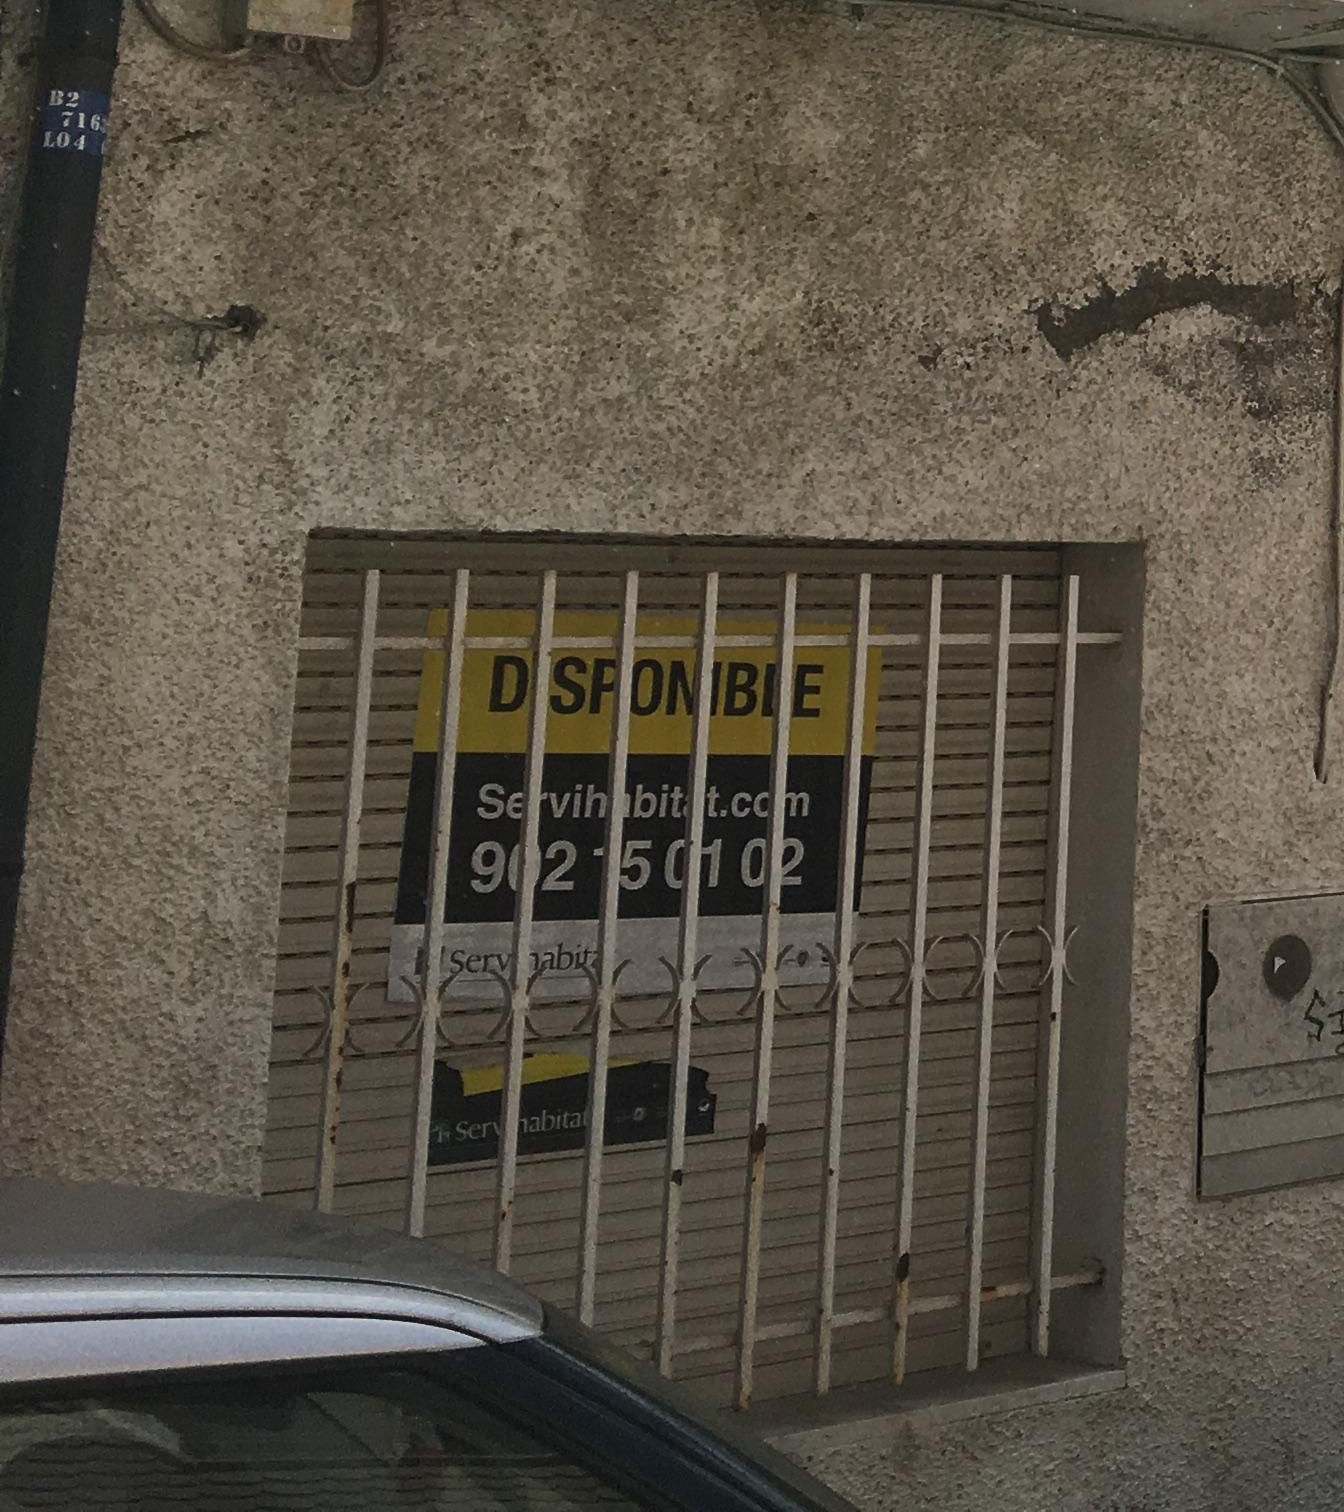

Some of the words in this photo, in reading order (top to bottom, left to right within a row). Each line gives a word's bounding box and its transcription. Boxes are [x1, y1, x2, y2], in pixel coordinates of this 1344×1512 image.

[48, 90, 80, 108] B2
[488, 655, 825, 718] DSPONIBLE
[470, 840, 578, 895] 902
[593, 839, 653, 890] 5
[664, 838, 723, 889] 01
[740, 838, 805, 889] 02
